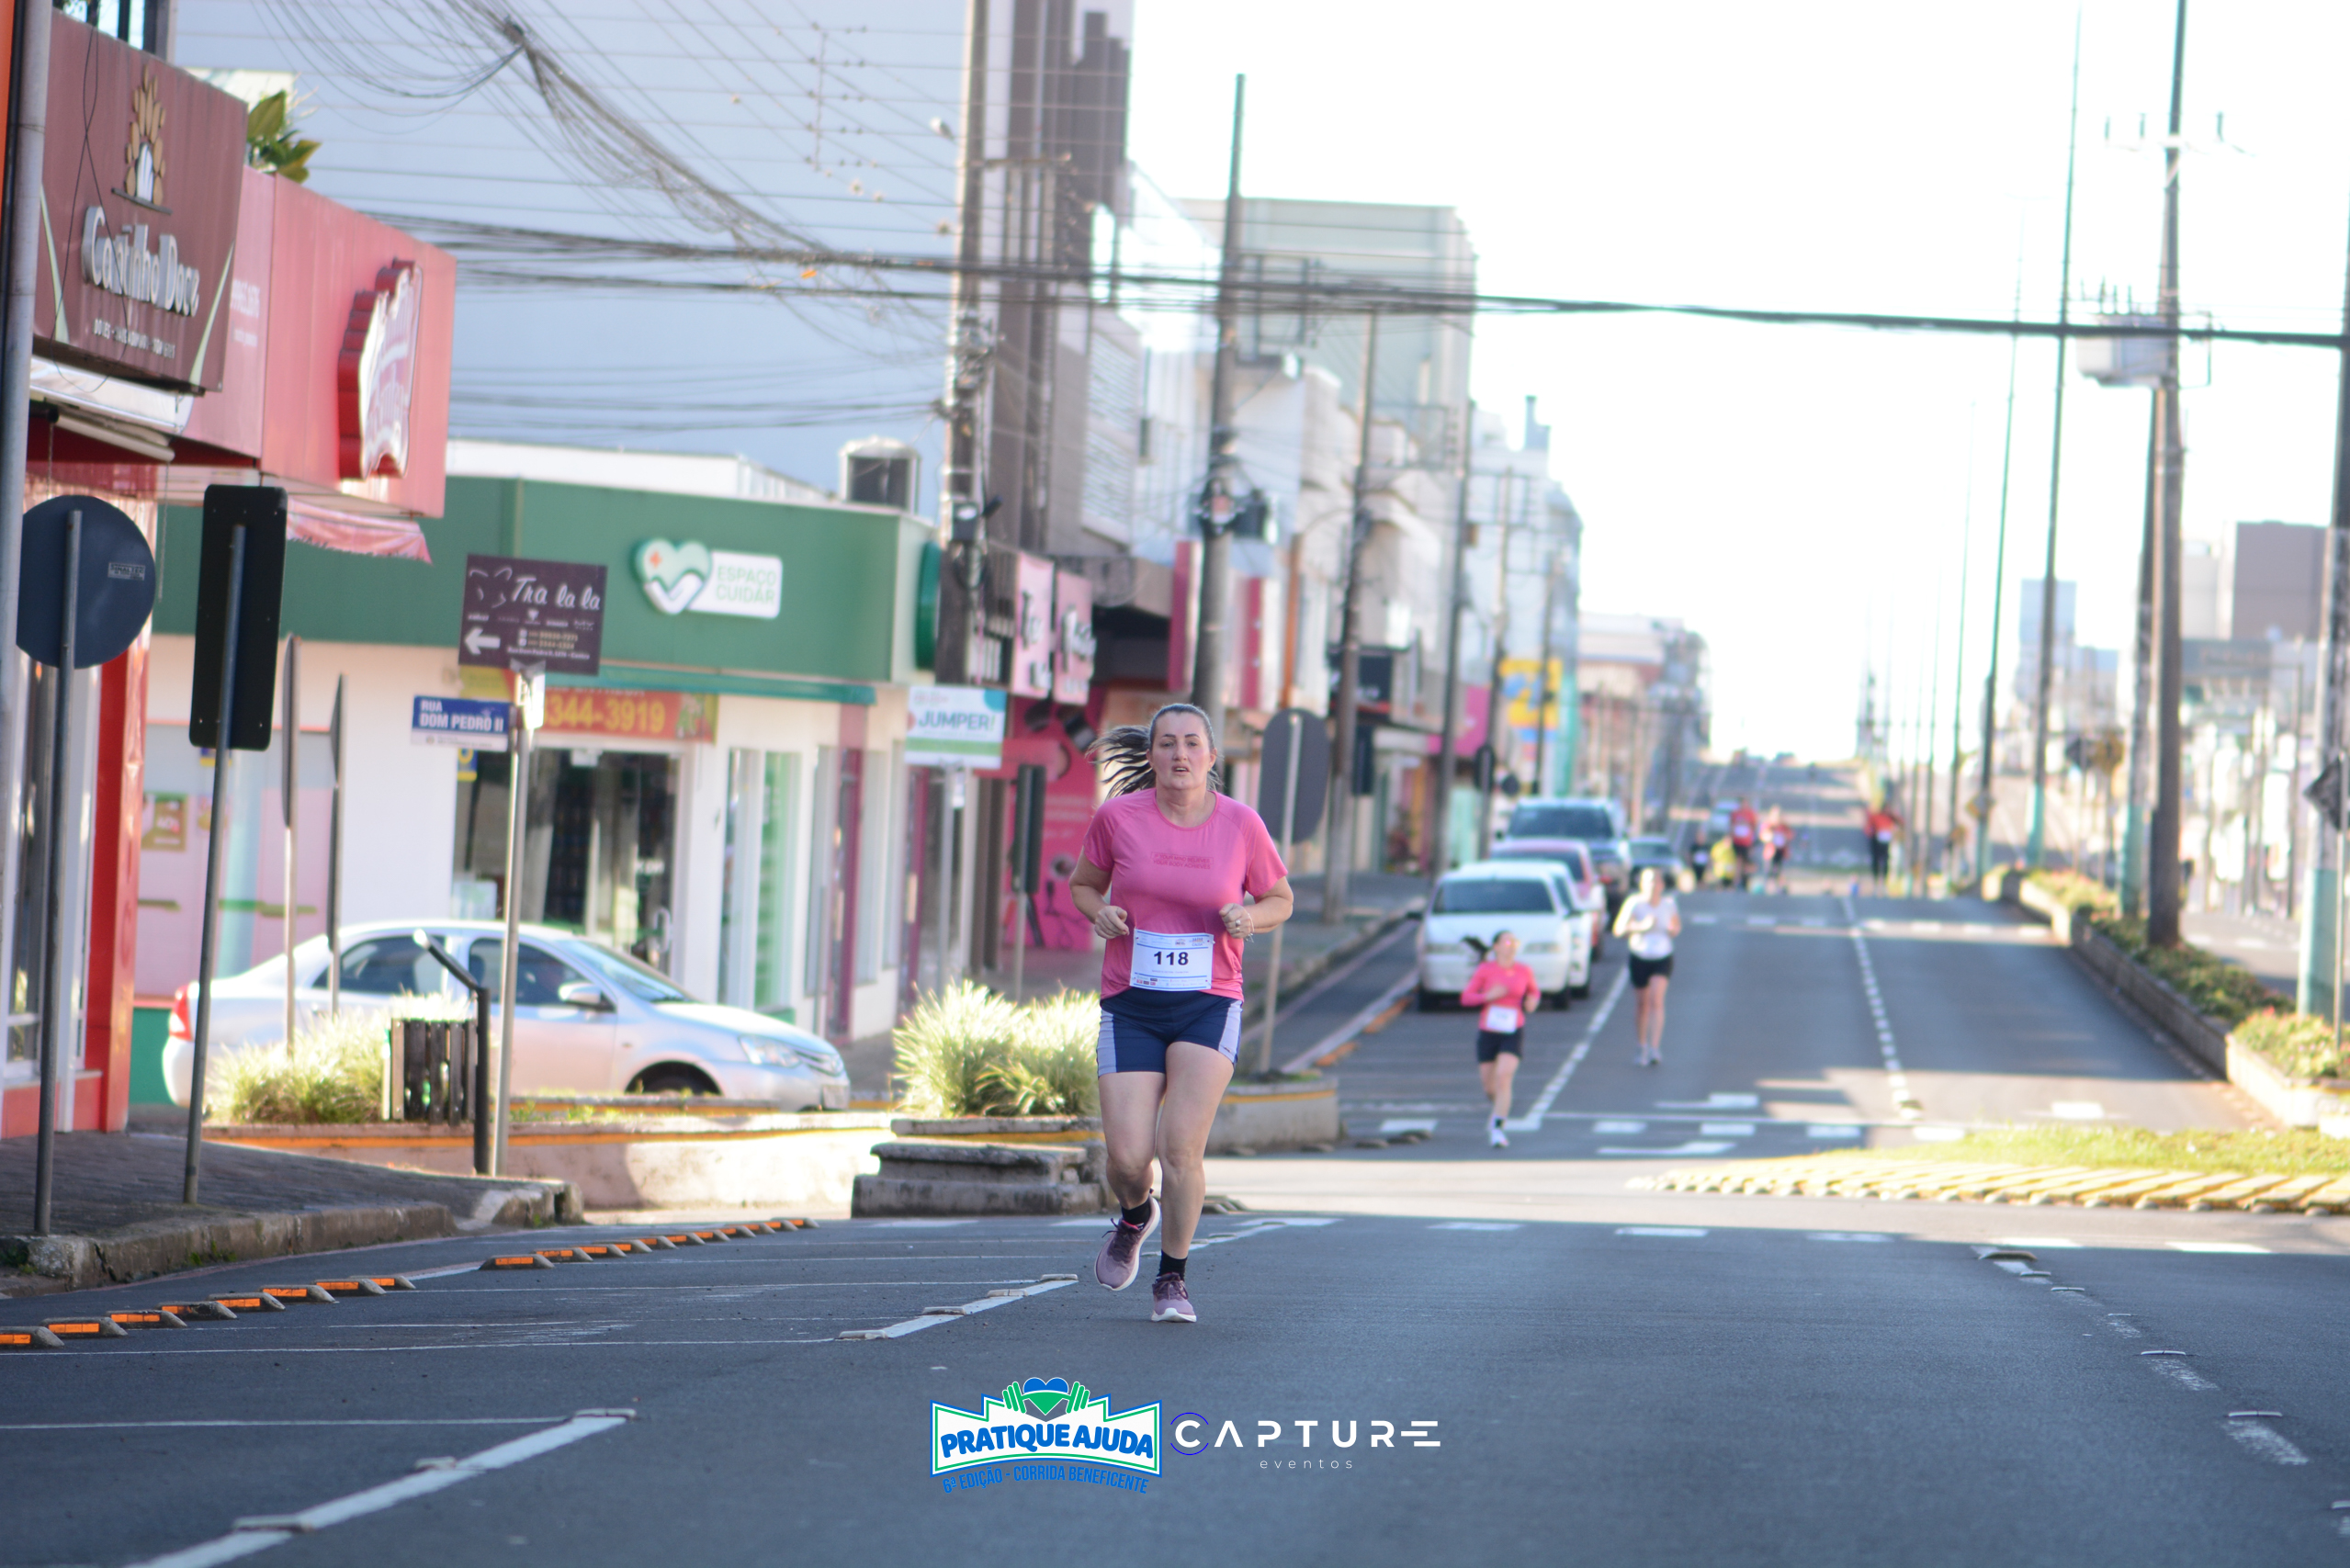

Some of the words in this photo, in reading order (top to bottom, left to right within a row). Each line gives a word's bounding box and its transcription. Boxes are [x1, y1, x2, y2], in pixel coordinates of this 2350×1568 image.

[160, 233, 200, 317] Doce
[512, 576, 548, 605] Tra
[556, 583, 576, 608] la
[580, 586, 601, 611] la
[716, 583, 775, 605] CUIDAR
[420, 699, 444, 713] RUA
[544, 694, 666, 733] 344-3919
[419, 712, 449, 729] DOM
[451, 714, 492, 732] PEDRO
[493, 717, 504, 732] II
[1153, 951, 1189, 966] 118
